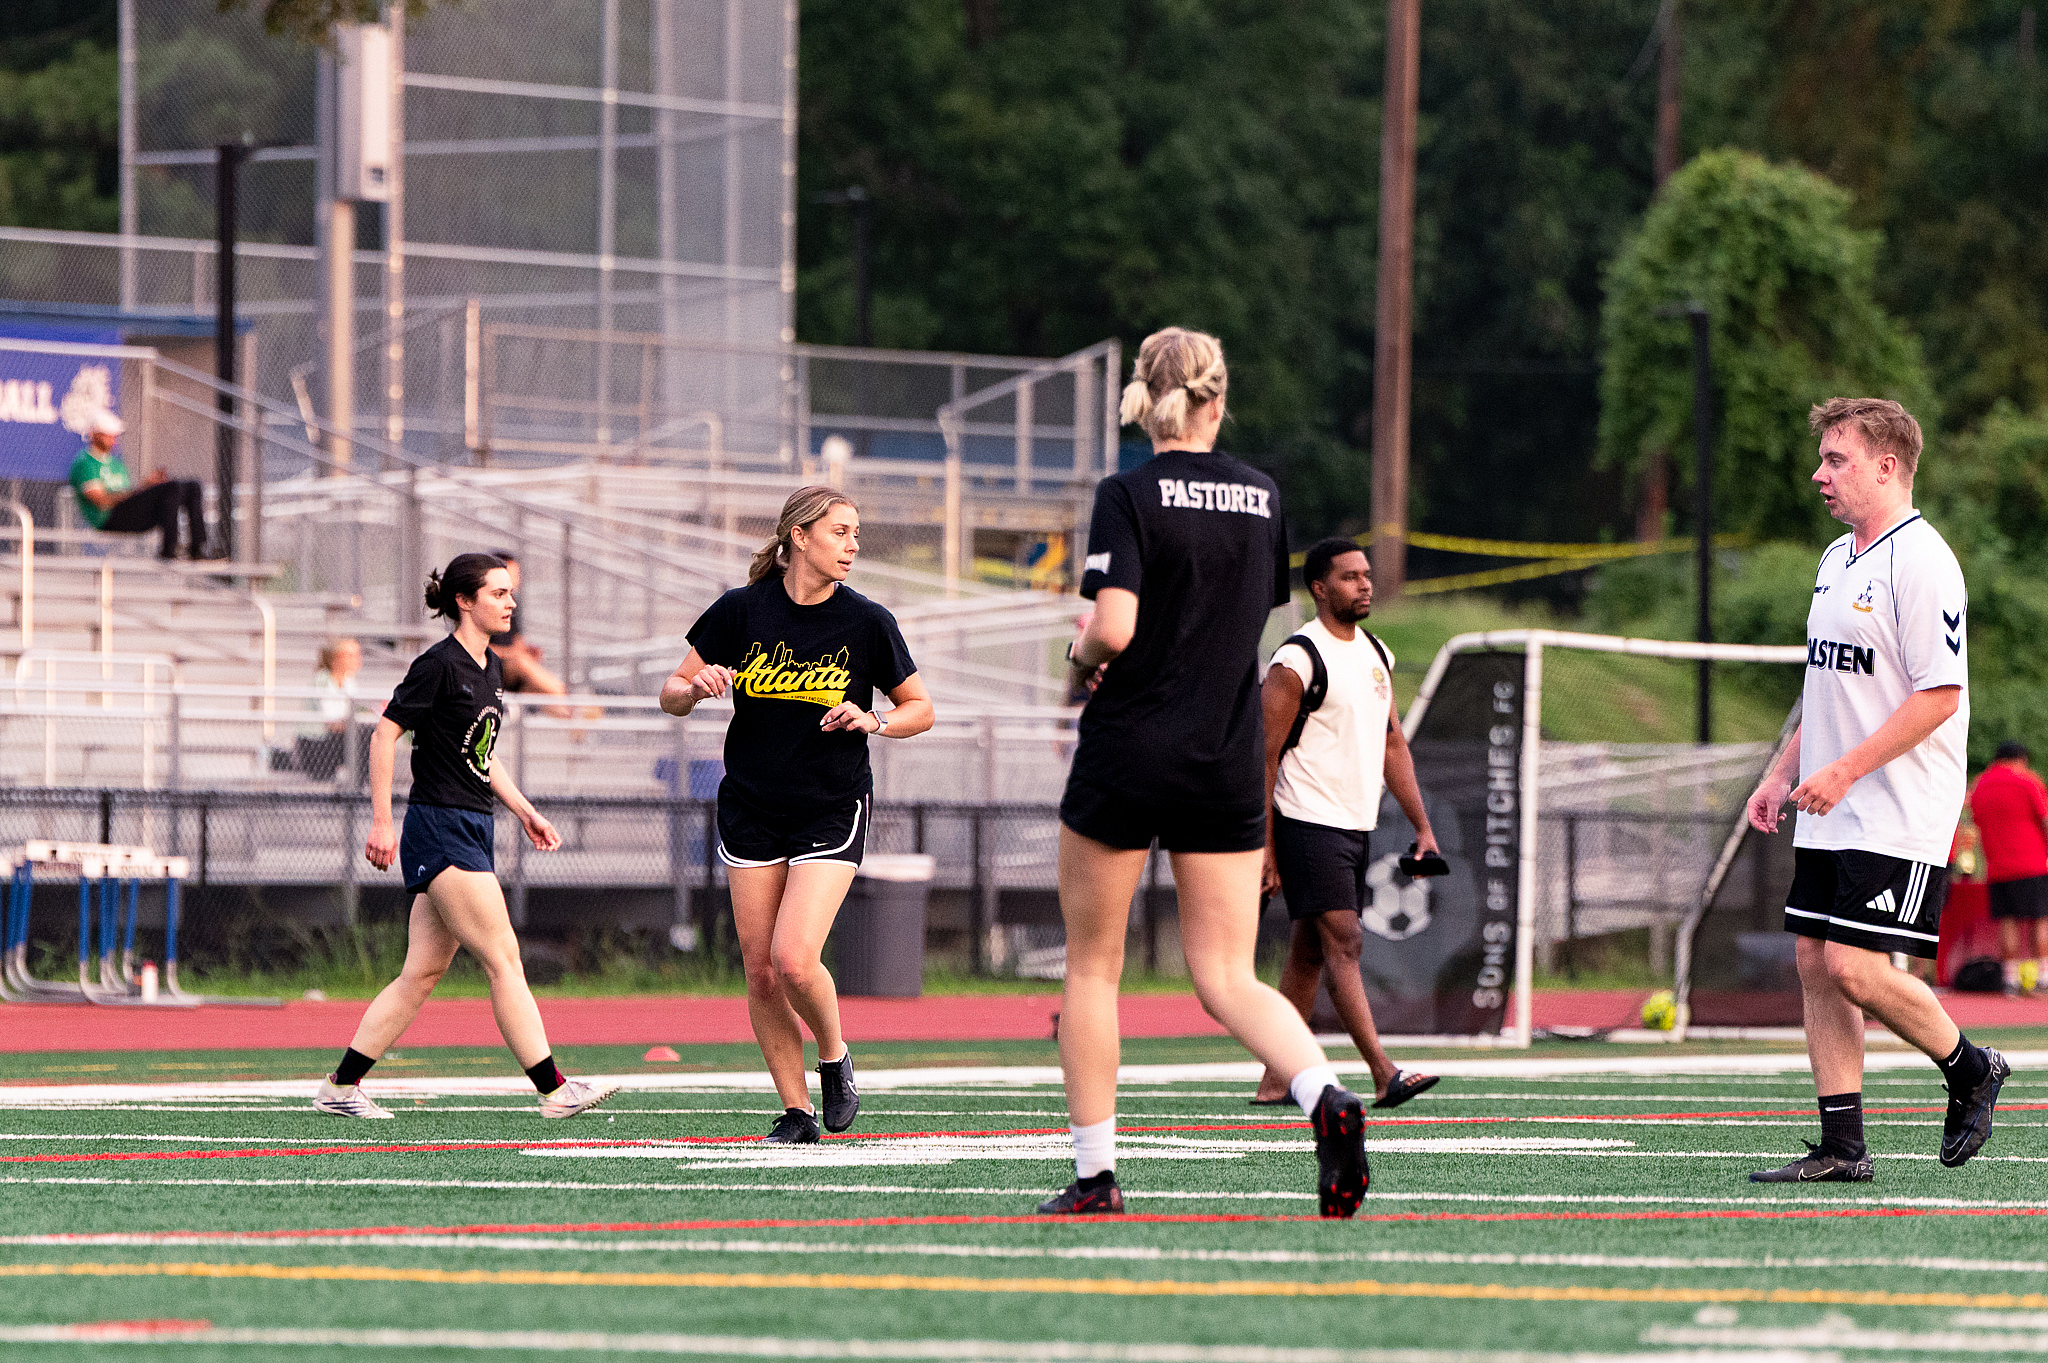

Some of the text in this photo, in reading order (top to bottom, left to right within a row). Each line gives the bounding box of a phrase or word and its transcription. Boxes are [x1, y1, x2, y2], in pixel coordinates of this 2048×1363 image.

[0, 379, 57, 423] ALL
[1158, 478, 1271, 519] PASTOREK
[734, 652, 852, 694] Atlanta
[1493, 681, 1515, 713] FC
[463, 721, 478, 746] HASPA
[1485, 725, 1515, 867] PITCHES
[1472, 921, 1511, 1009] SONS
